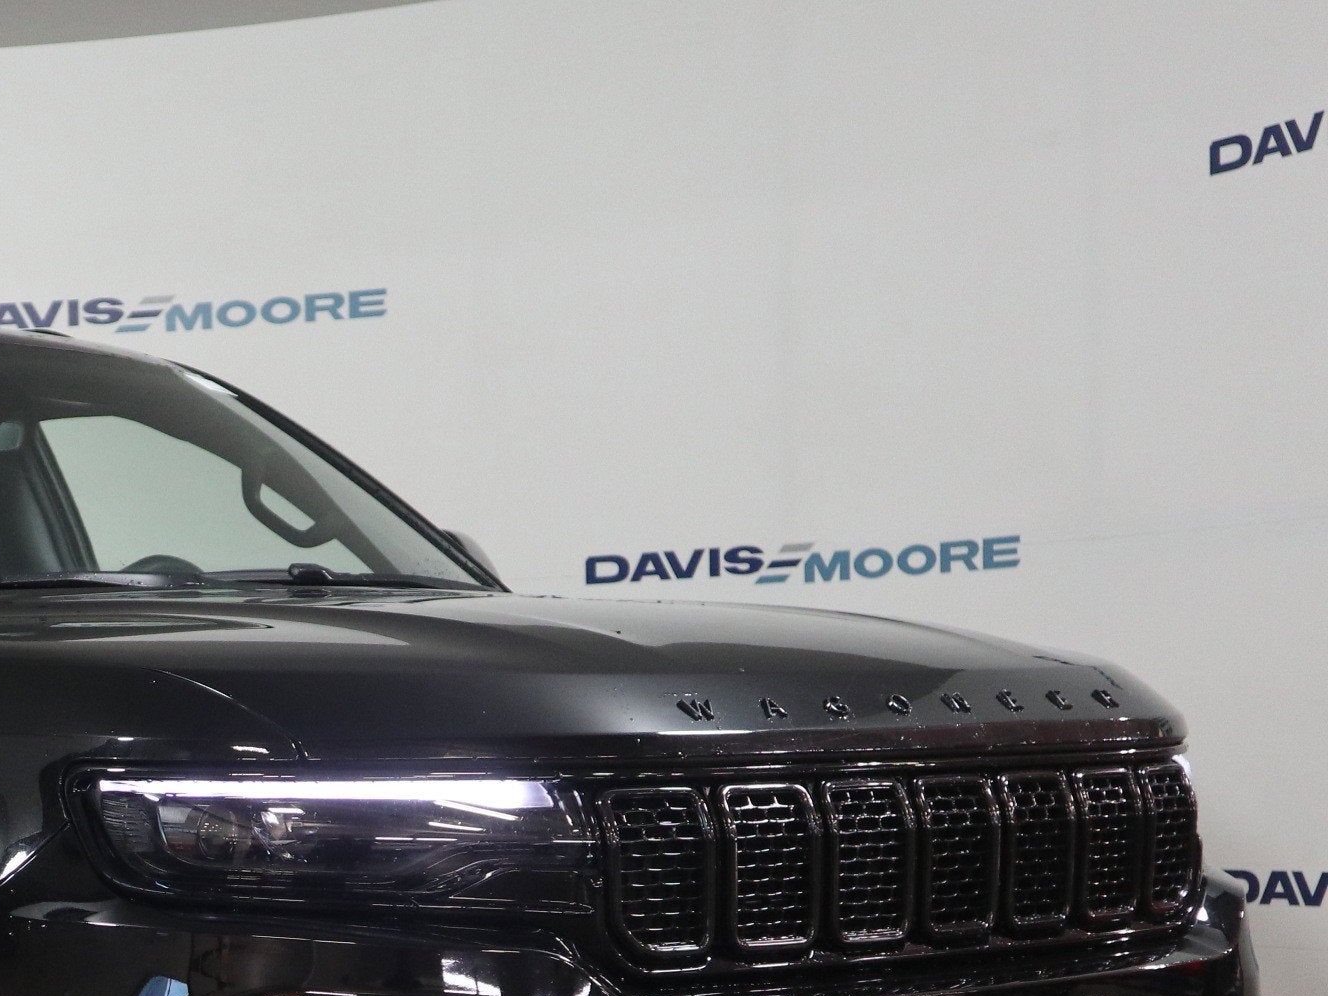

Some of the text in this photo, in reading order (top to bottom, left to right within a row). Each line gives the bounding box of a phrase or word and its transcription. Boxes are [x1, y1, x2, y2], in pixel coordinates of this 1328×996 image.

[1209, 109, 1325, 176] DAV
[165, 288, 388, 332] MOORE
[585, 535, 1021, 585] DAVIS MOORE
